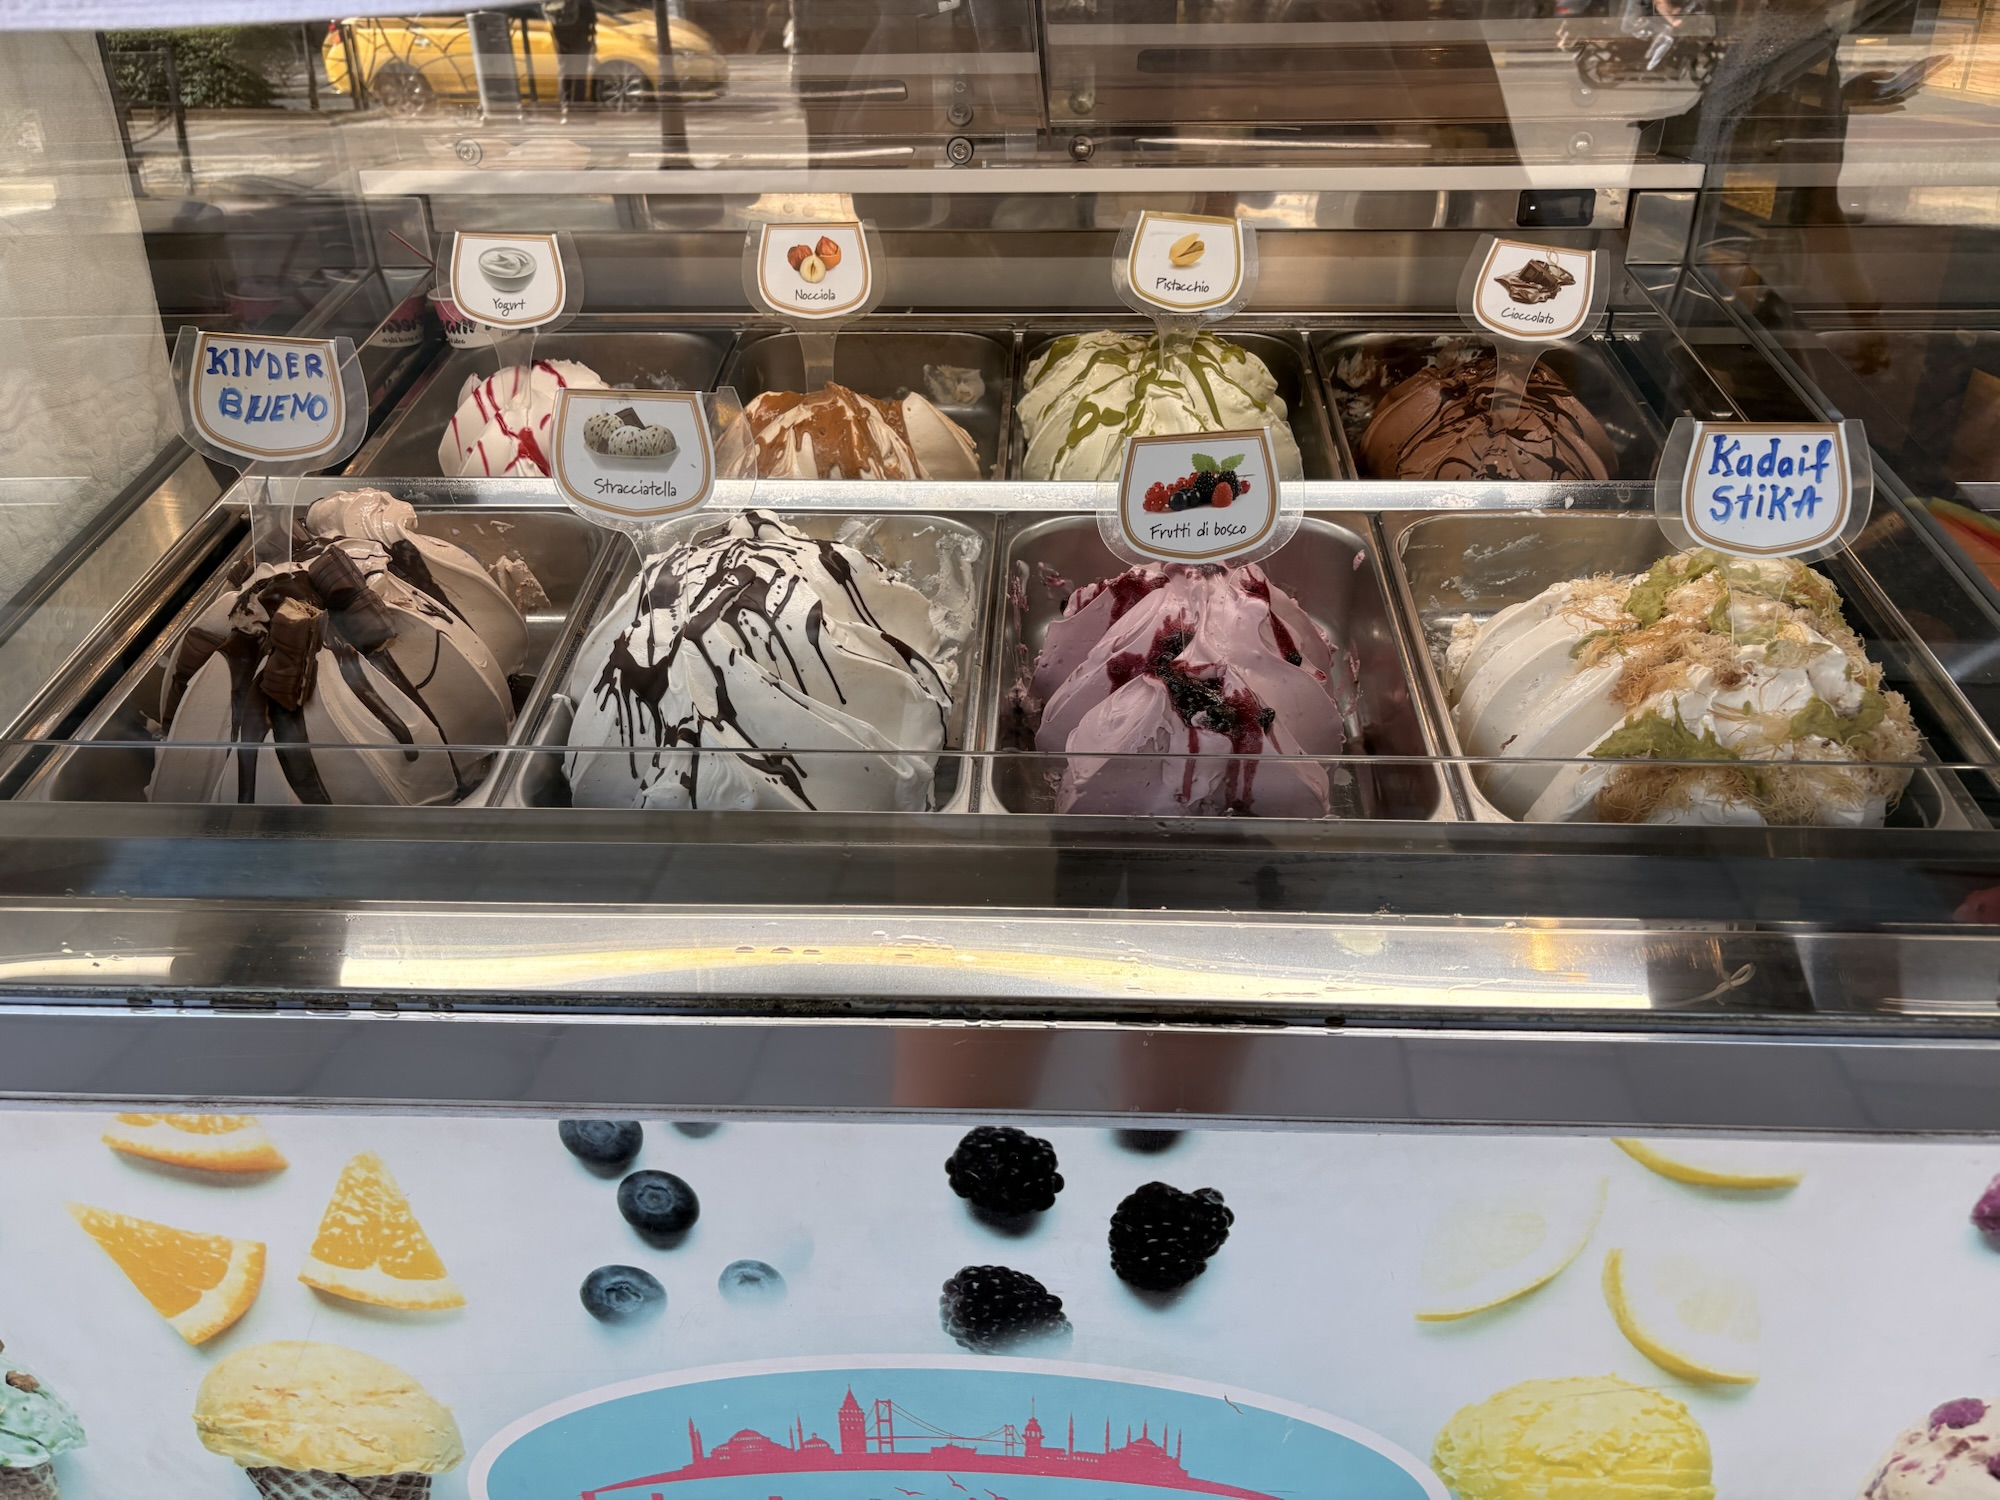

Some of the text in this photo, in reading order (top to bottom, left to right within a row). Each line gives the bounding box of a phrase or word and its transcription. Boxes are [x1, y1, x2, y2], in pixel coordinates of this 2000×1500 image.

[795, 288, 836, 301] Nocciola
[1156, 277, 1210, 293] Pistacchio
[492, 297, 526, 317] Yogurt
[1501, 307, 1554, 325] Cioccolato
[206, 346, 324, 380] KINDER
[218, 387, 328, 424] BUENO
[1708, 434, 1832, 484] Kadaif
[594, 478, 677, 497] Stracciatella
[1149, 521, 1247, 540] Frutti di bosco
